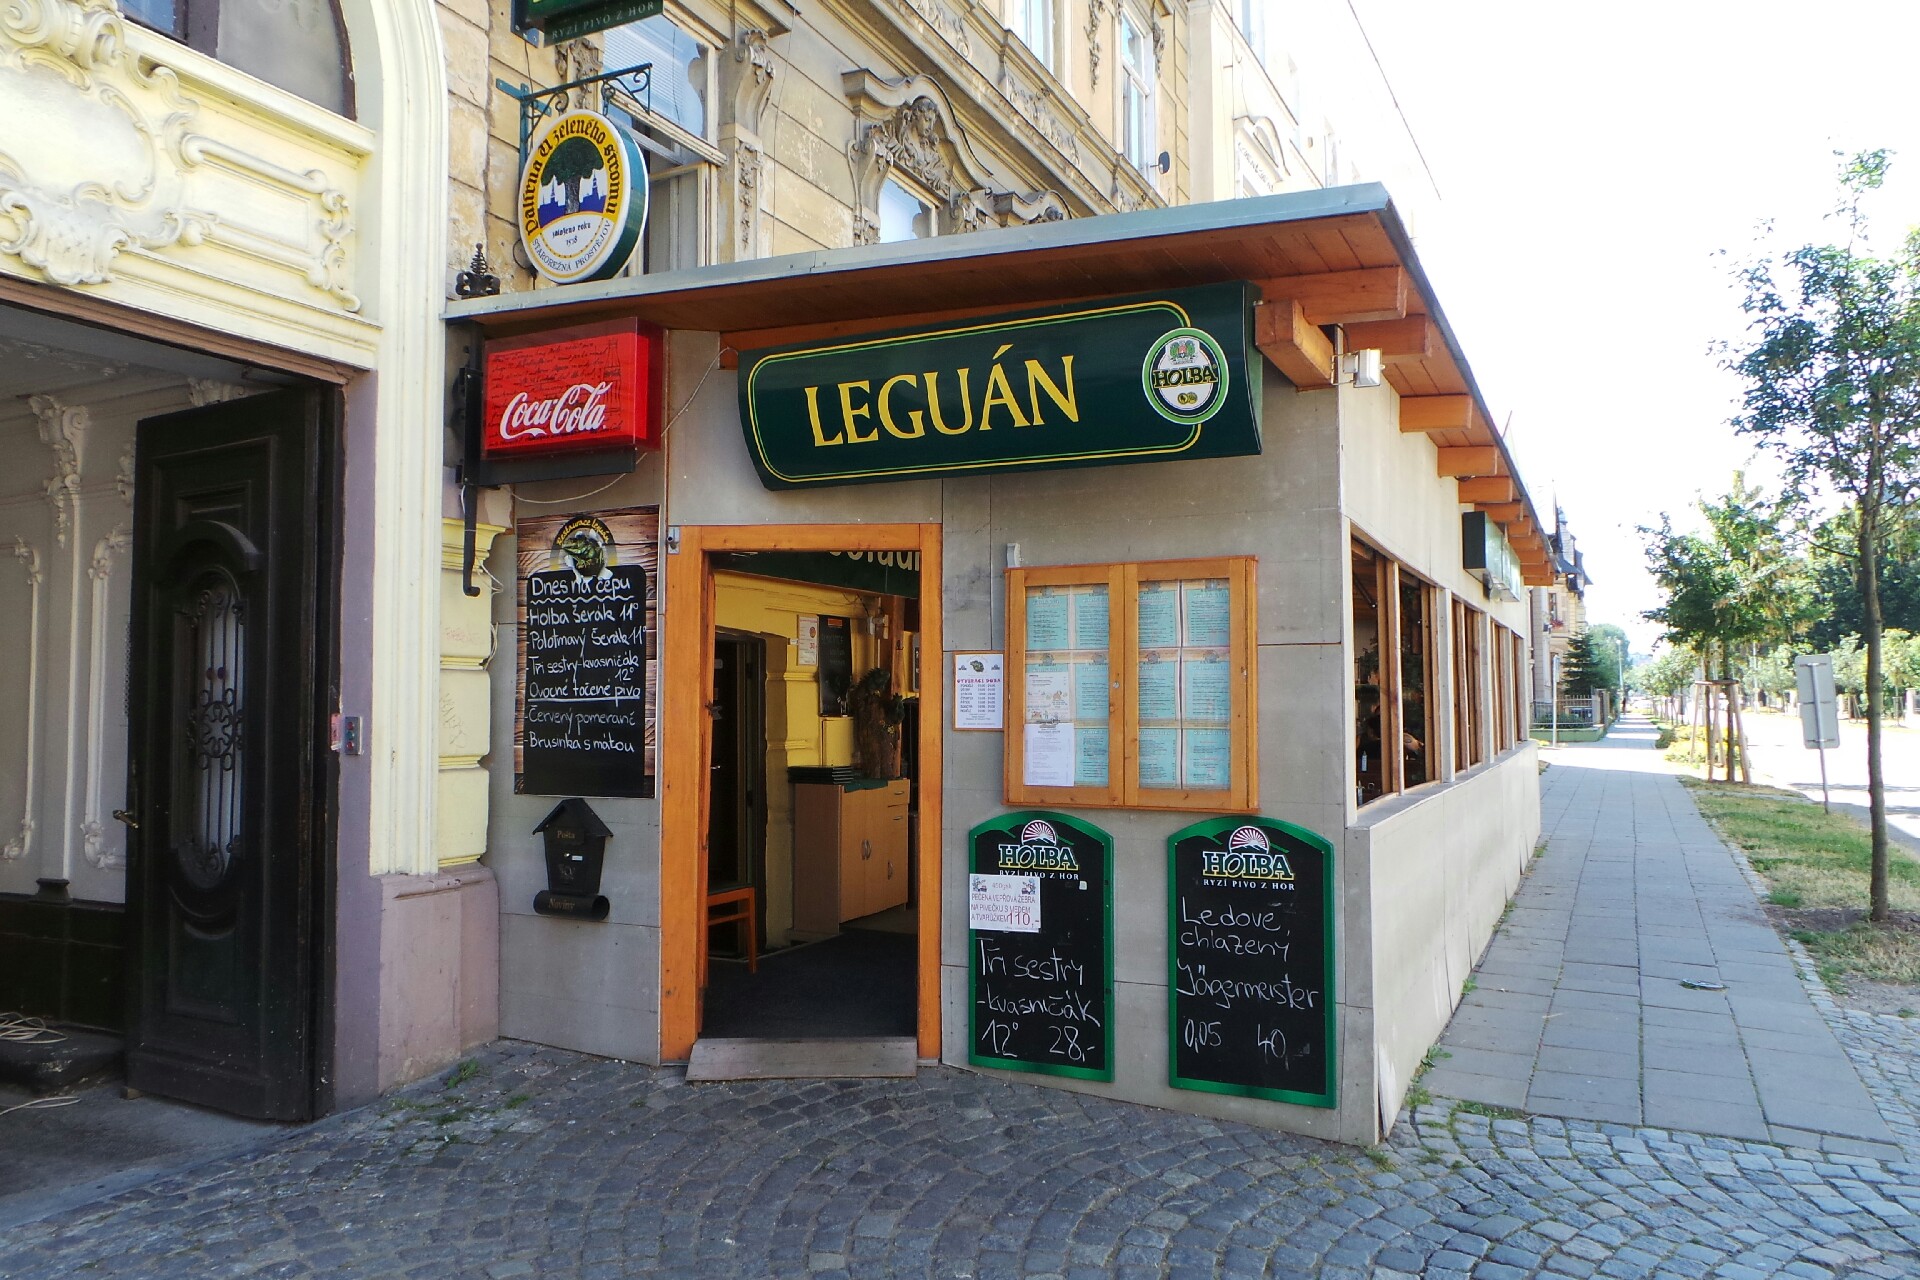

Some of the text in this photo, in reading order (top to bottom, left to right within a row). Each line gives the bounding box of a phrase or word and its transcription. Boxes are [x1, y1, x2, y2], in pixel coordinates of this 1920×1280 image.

[551, 2, 654, 40] RYZÍ PIVO Z HOR
[523, 160, 543, 236] Palírna
[538, 138, 554, 157] U
[604, 144, 620, 214] stromu
[1153, 364, 1218, 388] HOLBA
[804, 344, 1080, 447] LEGUÁN
[500, 381, 613, 440] Coca-Cola
[531, 577, 568, 596] Dnes
[571, 579, 591, 594] na
[572, 603, 615, 624] Šerák
[591, 627, 630, 646] Šerák
[529, 678, 640, 708] Ovocné točené pivo
[584, 739, 591, 751] s
[593, 731, 635, 753] mátou
[998, 844, 1079, 871] HOLBA
[1203, 851, 1294, 880] HOLBA
[1025, 871, 1046, 879] PIVO
[1203, 879, 1227, 887] RYZÍ
[1010, 905, 1031, 913] MEDEM
[1181, 926, 1290, 962] chlazený
[976, 937, 1083, 985] Tři sestry
[1185, 1019, 1221, 1053] 0,05
